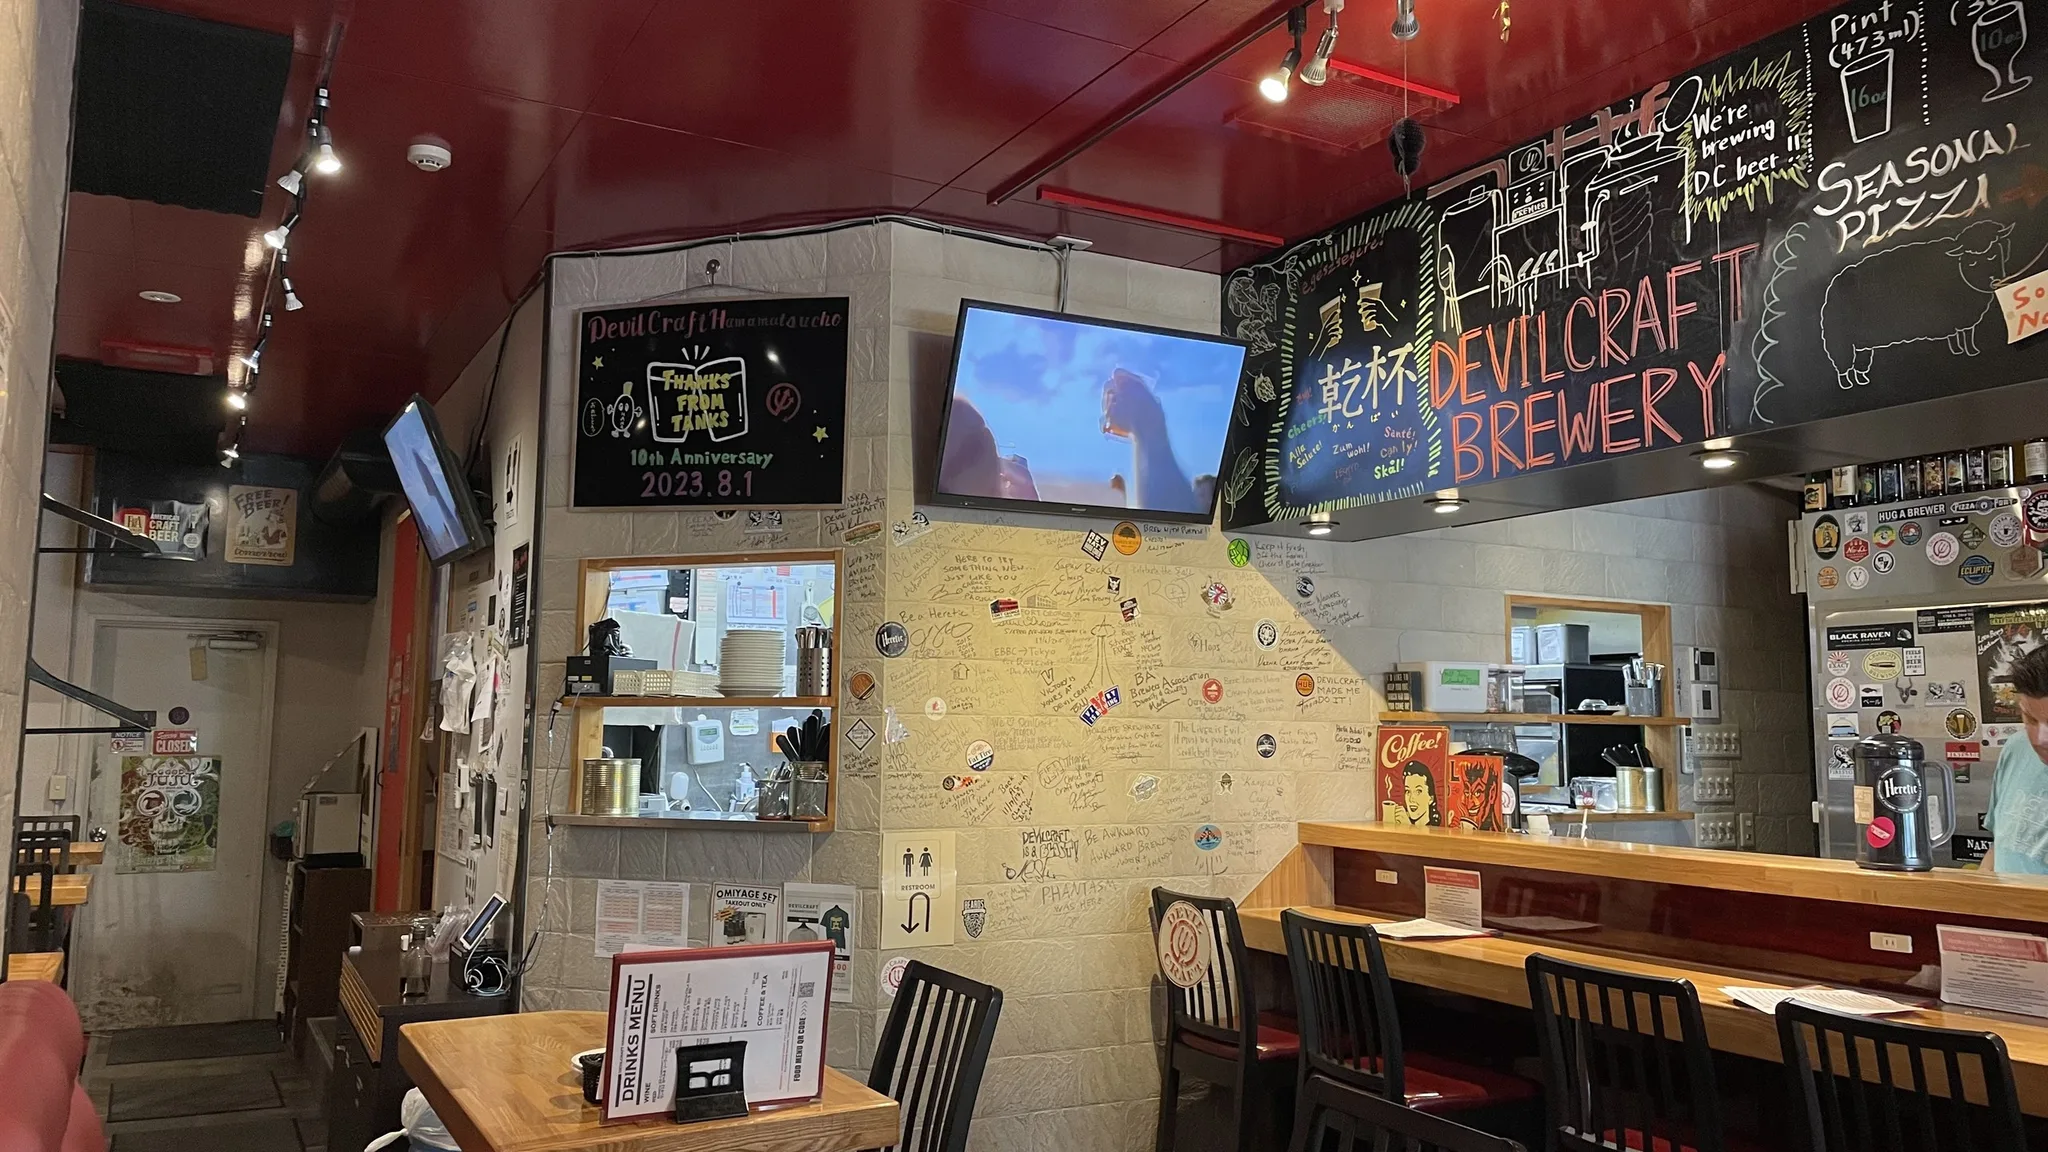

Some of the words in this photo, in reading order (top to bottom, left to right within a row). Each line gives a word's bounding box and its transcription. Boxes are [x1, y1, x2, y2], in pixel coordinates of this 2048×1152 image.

[1831, 2, 1893, 43] Pint
[1829, 11, 1920, 68] (473ml)
[1693, 104, 1748, 139] We're
[1702, 119, 1775, 159] brewing
[1695, 164, 1727, 195] DC
[1813, 123, 2031, 216] SEASONAL
[1836, 174, 1990, 253] PIZZA
[1431, 243, 1760, 408] DEVILCRAFT
[662, 370, 730, 390] THANKS
[1318, 342, 1418, 424] 乾杯
[676, 393, 725, 412] FROM
[671, 411, 729, 432] TANKS
[1287, 414, 1328, 439] Cheers!
[1454, 351, 1727, 483] BREWERY
[1384, 426, 1416, 439] Santé!
[630, 448, 664, 466] 10th
[670, 447, 774, 469] Anniversary
[1289, 444, 1306, 462] Alla
[1296, 440, 1323, 468] Salute!
[1333, 442, 1353, 455] Zum
[1347, 442, 1370, 458] wohl!
[1374, 458, 1405, 480] Skål!
[641, 470, 753, 498] 2023.8.1
[234, 489, 273, 511] FREE
[244, 495, 290, 519] BEER!
[1879, 511, 1898, 522] HUG
[1899, 508, 1907, 518] A
[1907, 503, 1946, 517] BREWER
[149, 520, 180, 531] CRAFT
[148, 531, 179, 542] BEER
[1090, 531, 1107, 547] REV
[1255, 540, 1275, 550] Keep
[943, 564, 998, 573] SOMETHING
[955, 555, 977, 563] HERE
[1960, 564, 1993, 576] ECLIPTIC
[899, 610, 915, 623] Be
[881, 631, 904, 648] Heretic
[1829, 633, 1859, 641] BLACK
[1860, 631, 1892, 639] RAVEN
[1040, 677, 1067, 697] VICTORY
[1134, 671, 1156, 686] BA
[1297, 680, 1313, 688] HUB
[1316, 676, 1366, 685] DEVILCRAFT
[1040, 692, 1063, 708] YOURS
[1065, 684, 1072, 694] AT
[1316, 687, 1343, 695] MADE
[1346, 687, 1361, 695] ME
[1317, 696, 1330, 704] DO
[968, 756, 979, 765] Fat
[979, 749, 992, 759] Tire
[1381, 732, 1442, 768] Coffee!
[143, 772, 196, 787] JUJU
[1884, 777, 1918, 799] Heretic
[1103, 826, 1149, 841] AWKWARD
[1090, 841, 1134, 865] AWKWARD
[716, 888, 760, 899] OMIYAGE
[762, 892, 778, 904] SET
[1041, 879, 1117, 904] PHANTASM
[1167, 906, 1204, 935] DEVIL
[1164, 952, 1204, 981] CRAFT
[629, 979, 646, 1031] MENU
[653, 984, 661, 1013] DRINKS
[757, 997, 765, 1026] COFFEE
[650, 1013, 658, 1034] SOFT
[798, 1017, 806, 1034] CODE
[797, 1035, 804, 1045] QR
[796, 1045, 804, 1061] MENU
[622, 1034, 640, 1102] DRINKS
[793, 1061, 802, 1082] FOOD
